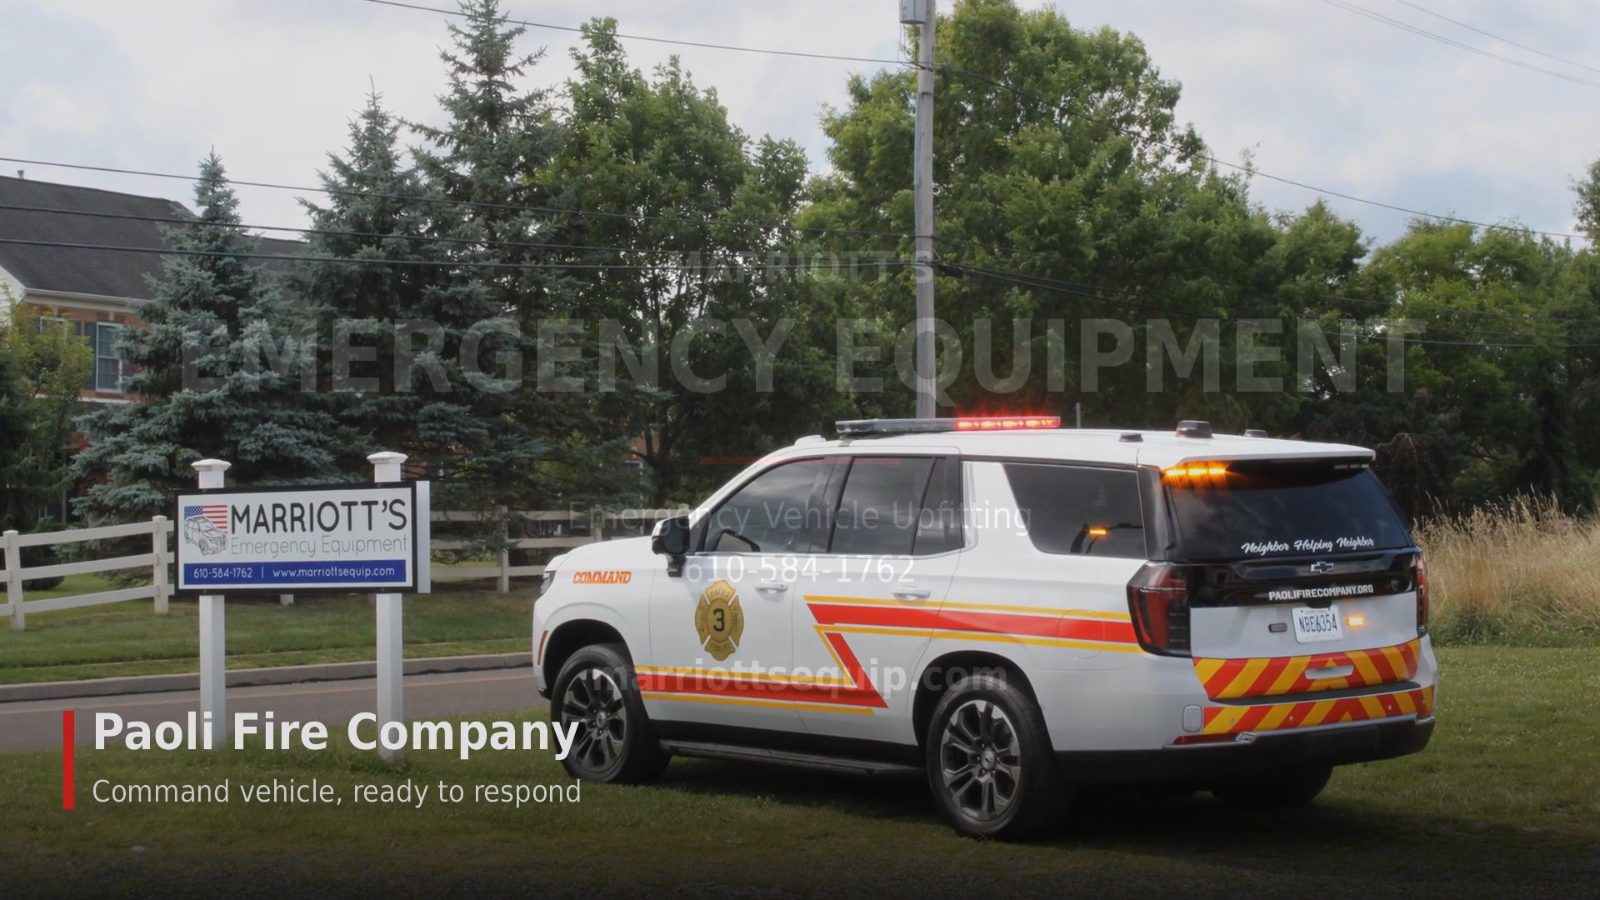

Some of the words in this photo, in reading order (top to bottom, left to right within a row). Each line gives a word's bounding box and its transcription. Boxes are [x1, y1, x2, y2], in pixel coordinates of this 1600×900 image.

[231, 499, 407, 534] MARRIOTT'S
[231, 537, 316, 558] Emergency
[322, 534, 407, 557] Equipment
[1241, 541, 1290, 556] Neighbor
[1294, 539, 1333, 552] Helping
[1336, 536, 1374, 550] Neighbor
[193, 568, 253, 579] 610-584-1762
[272, 566, 395, 579] www.marriottsequip.com
[573, 571, 632, 584] COMMAND
[1268, 584, 1374, 601] PAOLIFIRECOMPANY.ORG
[713, 608, 725, 632] 3
